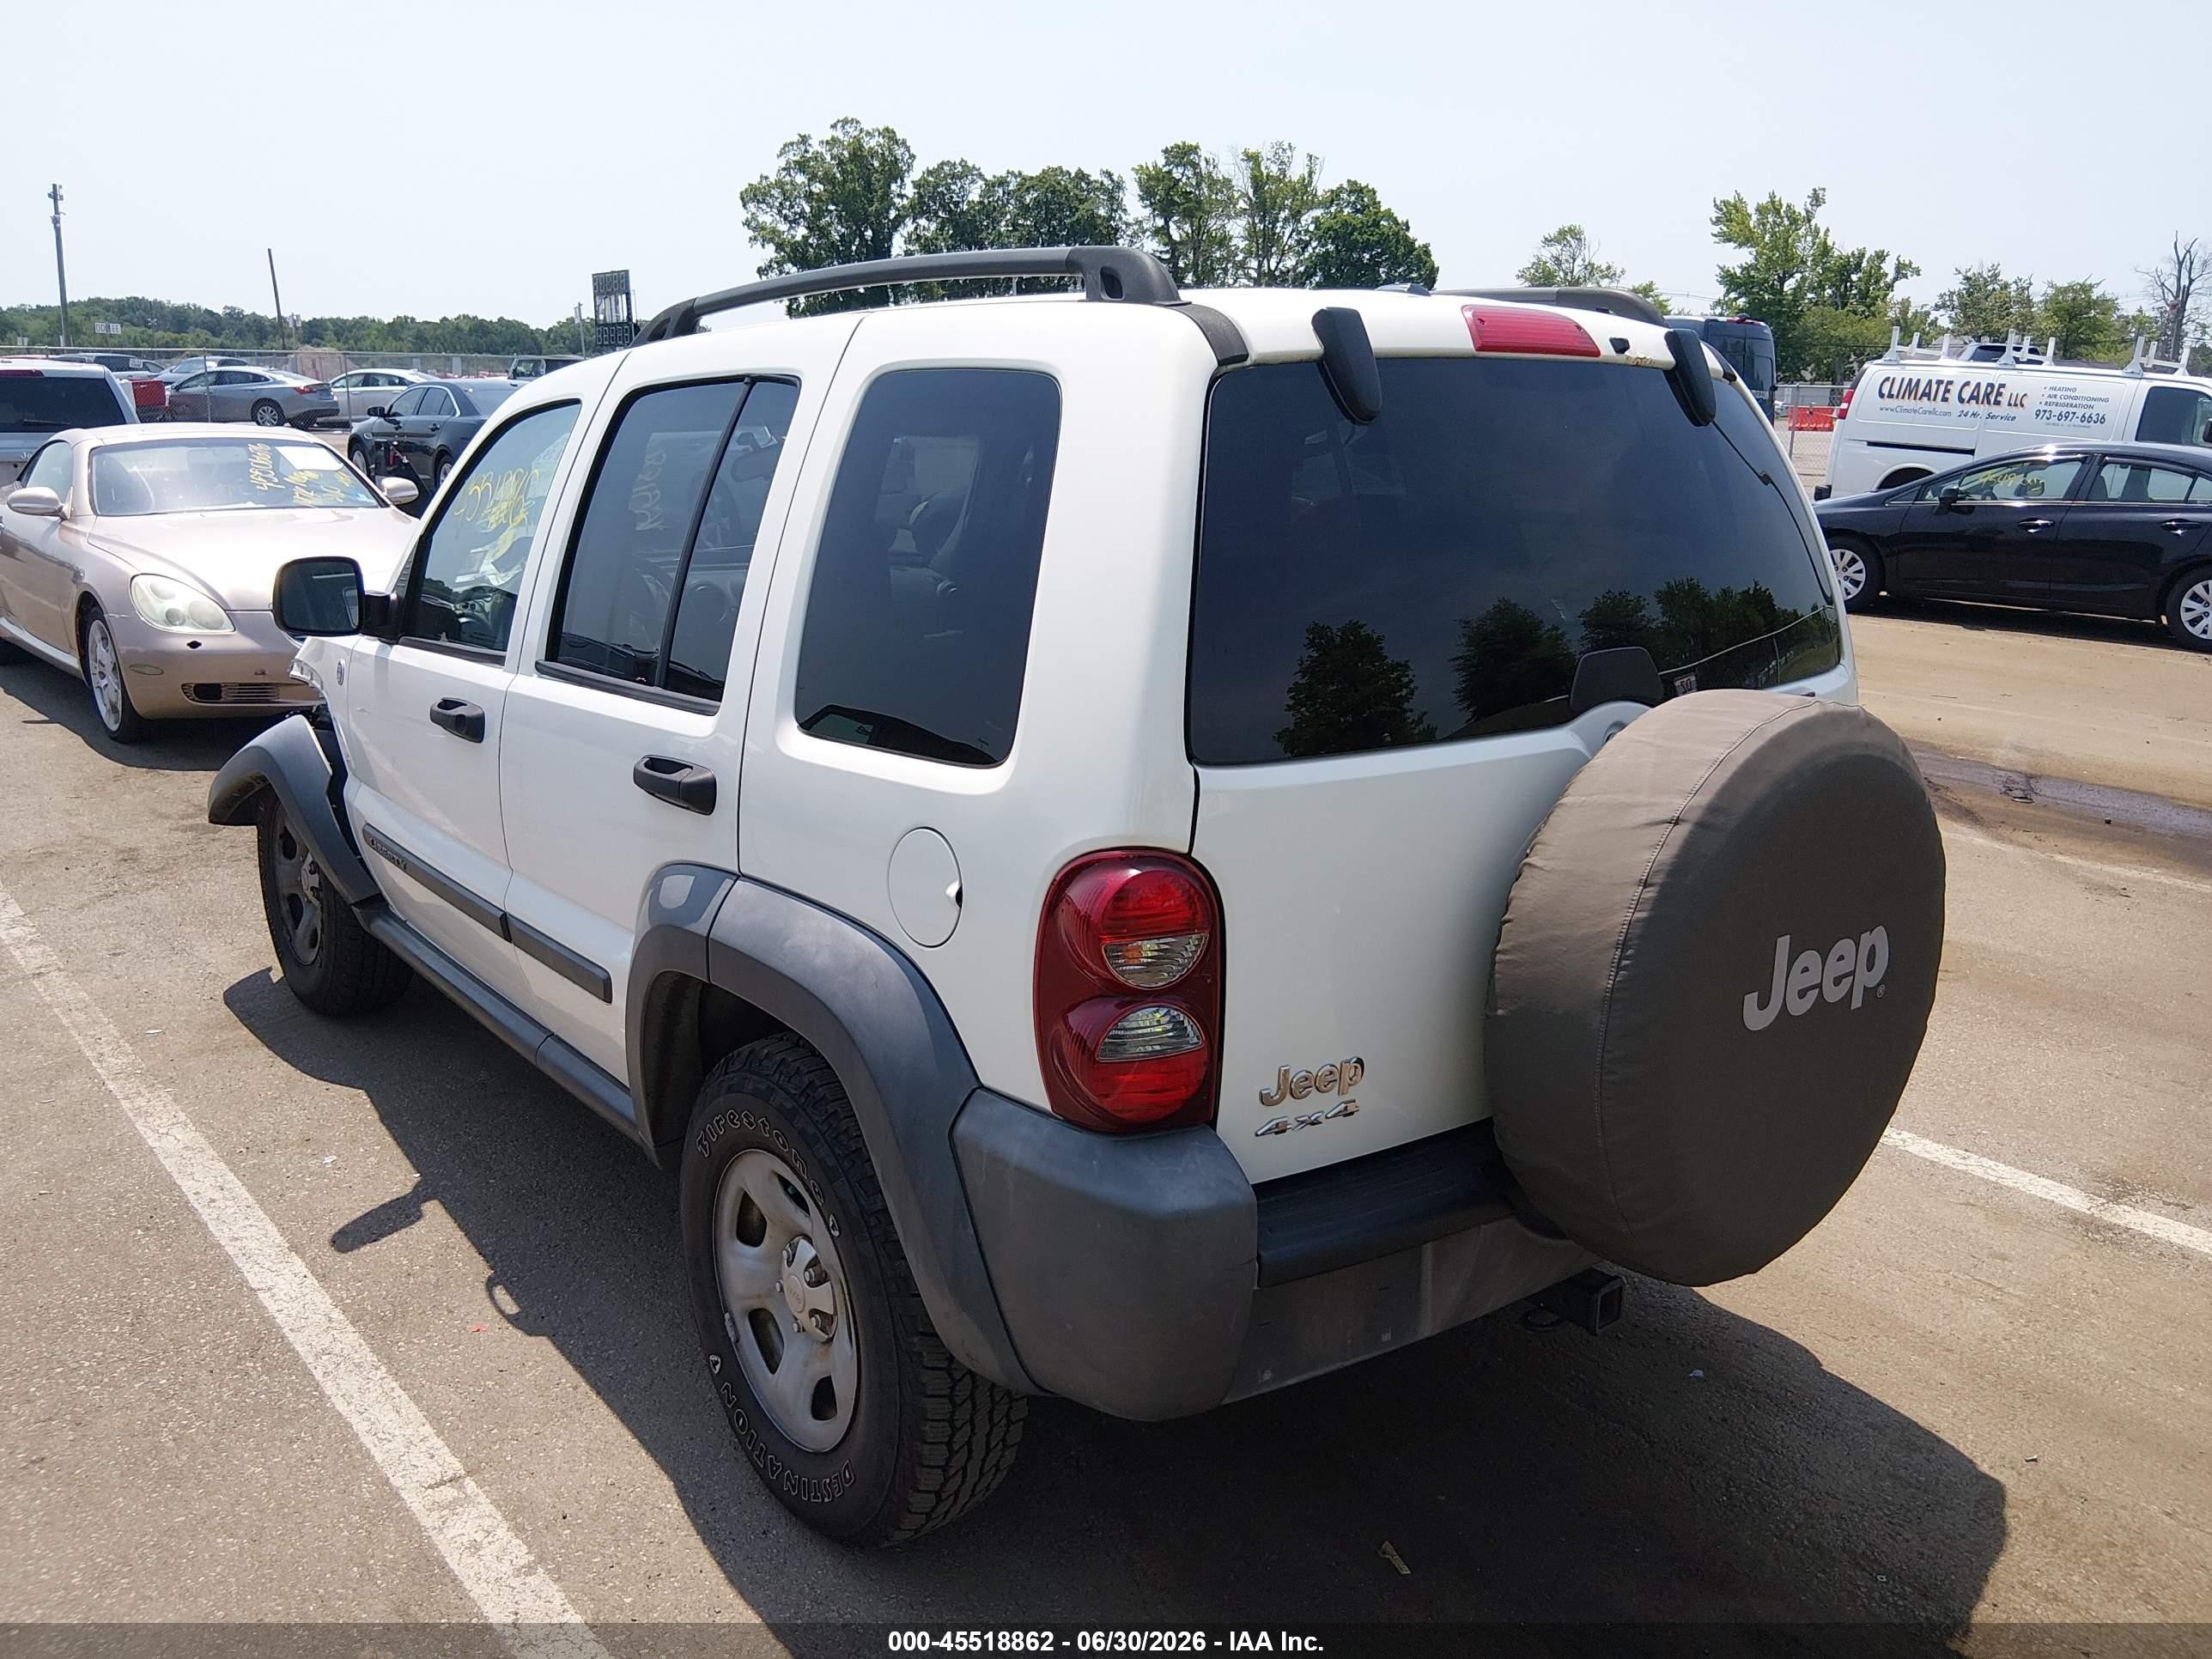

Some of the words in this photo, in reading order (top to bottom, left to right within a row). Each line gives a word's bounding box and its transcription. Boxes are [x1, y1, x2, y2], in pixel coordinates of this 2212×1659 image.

[1878, 376, 1954, 403] CLIMATE
[1957, 380, 2006, 406] CARE
[2007, 392, 2027, 408] LLC
[2059, 394, 2109, 403] CONDITIONING
[1957, 410, 1968, 418] 24
[1972, 410, 1982, 419] Hr.
[1985, 412, 2016, 422] Service
[2034, 409, 2106, 424] 973-697-6636
[1742, 925, 1889, 1030] Jeep
[1259, 1056, 1365, 1106] Jeep
[696, 1109, 824, 1206] Firestone
[720, 1382, 855, 1502] DESTINATION
